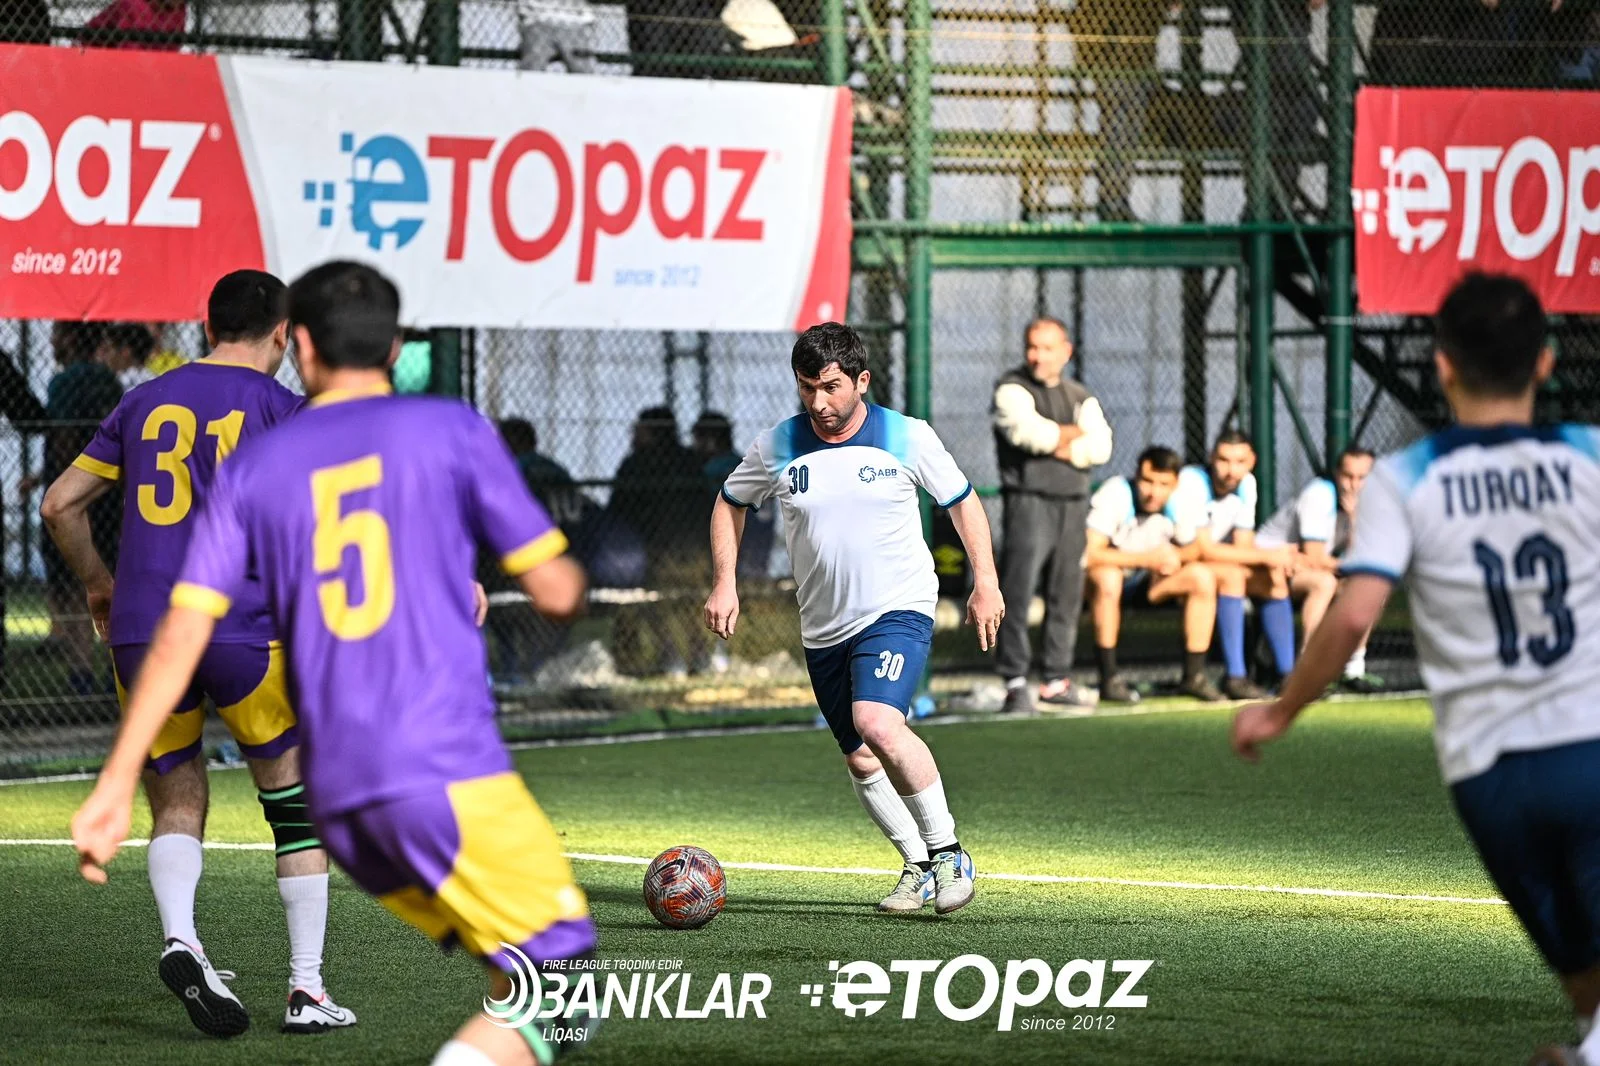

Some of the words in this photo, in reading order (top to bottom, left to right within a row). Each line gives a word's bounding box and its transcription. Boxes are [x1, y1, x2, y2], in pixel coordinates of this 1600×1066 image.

[348, 127, 767, 284] eTOpaz
[11, 246, 67, 274] since
[69, 247, 122, 275] 2012
[789, 465, 809, 494] 30
[877, 468, 898, 477] ABB
[1440, 458, 1574, 518] TURQAY
[310, 453, 396, 641] 5
[1473, 533, 1576, 669] 13
[874, 650, 905, 682] 30
